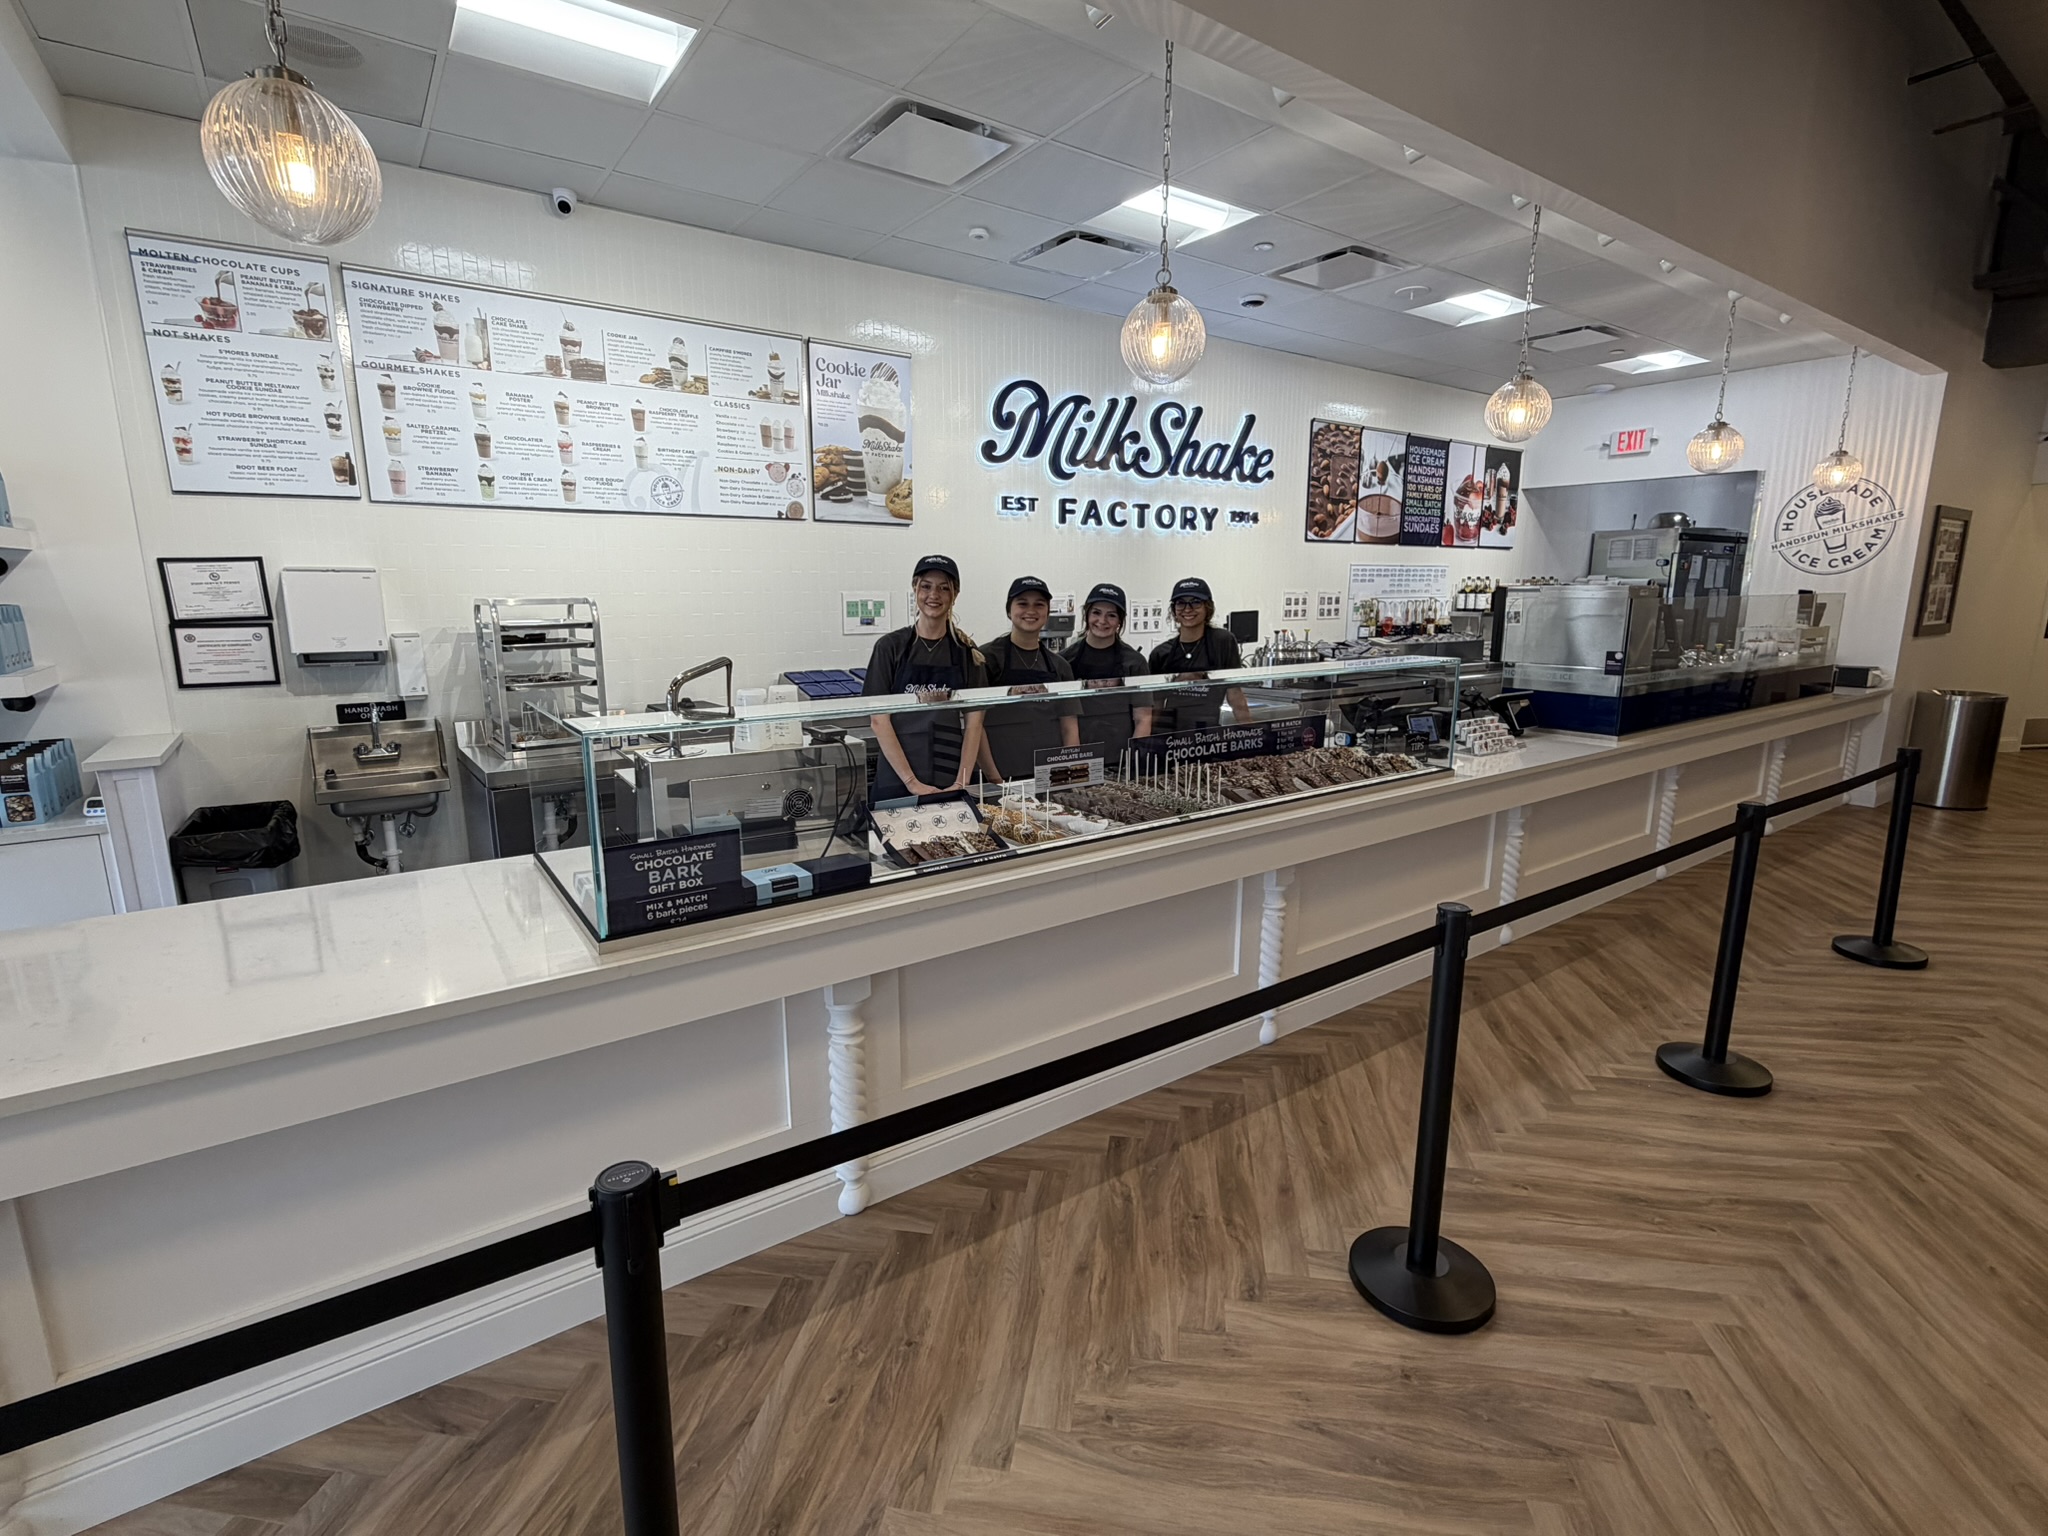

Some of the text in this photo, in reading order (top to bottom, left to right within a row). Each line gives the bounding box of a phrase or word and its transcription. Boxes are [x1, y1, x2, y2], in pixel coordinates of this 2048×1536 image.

[138, 248, 300, 276] MOLTEN CHOCOLATE CUPS
[140, 261, 197, 273] STRAWBERRIES
[240, 274, 295, 286] PEANUT BUTTER
[241, 280, 272, 288] BANANAS
[351, 280, 460, 303] SIGNATURE SHAKES
[359, 297, 423, 311] CHOCOLATE DIPPED
[359, 302, 404, 312] STRAWBERRY
[491, 316, 526, 325] CHOCOLATE
[152, 328, 231, 344] NOT SHAKES
[361, 360, 460, 378] GOURMET SHAKES
[816, 357, 866, 378] Cookie
[816, 373, 842, 389] Jar
[714, 400, 750, 410] CLASSICS
[981, 380, 1274, 483] MilkShake
[1617, 429, 1648, 452] EXIT
[1409, 445, 1446, 458] HOUSEMADE
[1409, 454, 1445, 467] ICE CREAM
[717, 466, 760, 474] NON-DAIRY
[1408, 464, 1445, 476] HANDSPUN
[1407, 474, 1444, 485] MILKSHAKES
[1418, 484, 1434, 493] YEARS
[1405, 507, 1441, 516] CHOCOLATES
[1424, 500, 1441, 508] BATCH
[1782, 484, 1883, 531] HOUSADE
[1001, 496, 1259, 531] EST FACTORY 1914
[1404, 515, 1440, 523] HANDCRAFTED
[1404, 522, 1439, 534] SUNDAES
[1771, 510, 1904, 550] HANDSPUN MILKSHAKES
[1792, 528, 1886, 568] ICE CREAM
[1166, 742, 1228, 761] CHOCOLATE
[1230, 738, 1263, 752] BARKS
[1047, 754, 1078, 762] CHOCOLATE
[635, 850, 714, 871] CHOCOLATE
[648, 863, 703, 884] BARK
[649, 878, 703, 894] GIFT BOX
[646, 902, 664, 911] MIX
[676, 894, 708, 905] MATCH
[656, 908, 677, 919] bark
[679, 903, 708, 915] pieces
